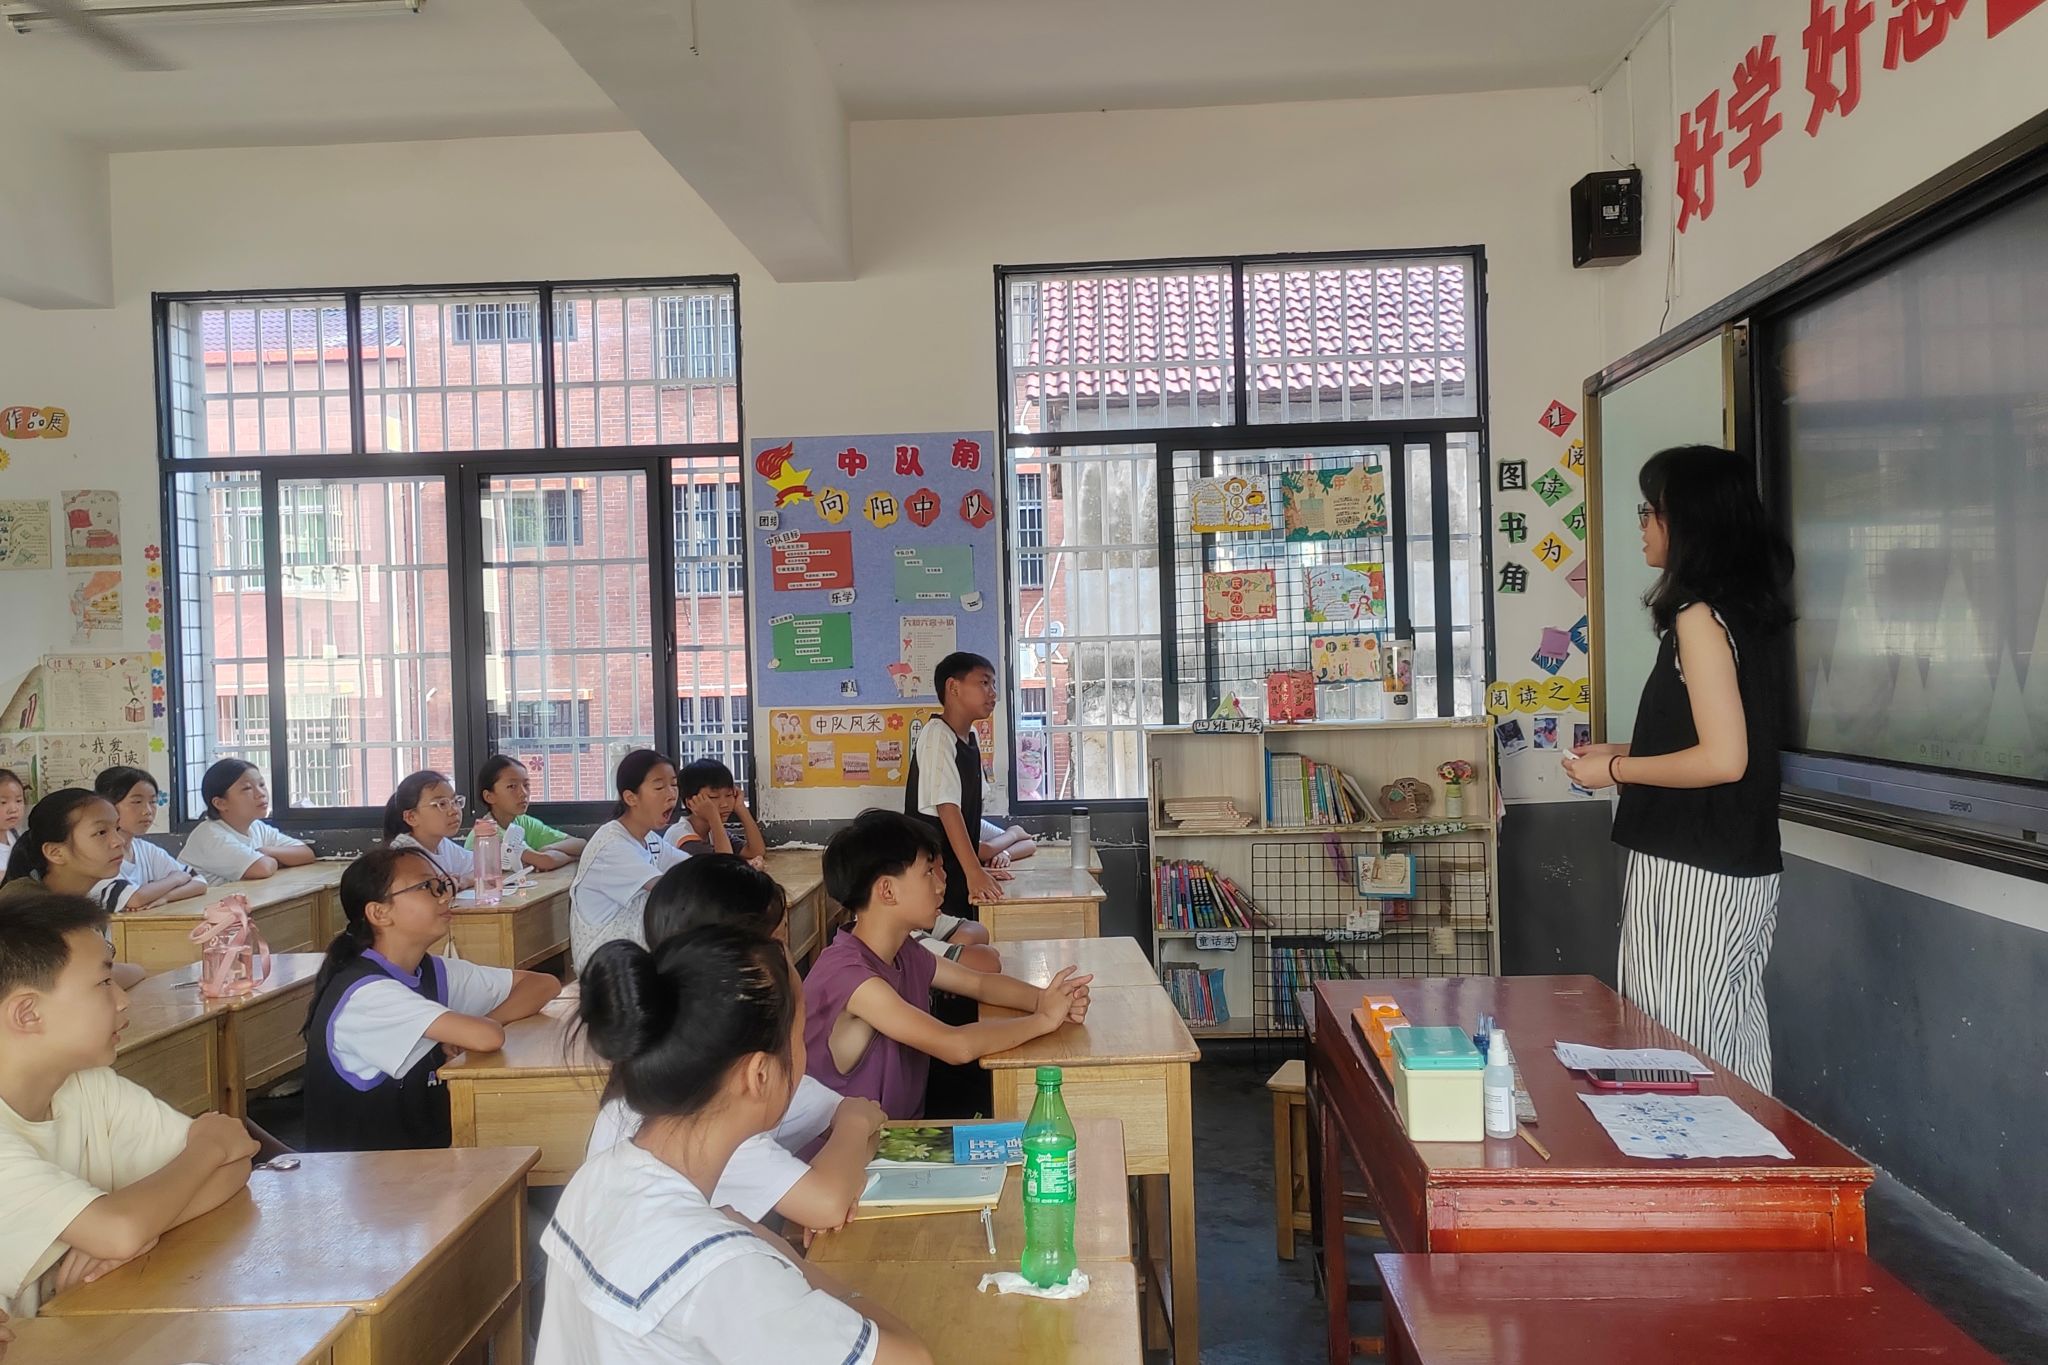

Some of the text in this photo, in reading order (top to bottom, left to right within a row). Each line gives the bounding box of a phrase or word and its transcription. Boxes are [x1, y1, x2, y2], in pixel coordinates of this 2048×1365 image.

[1674, 35, 1783, 233] 好学
[6, 408, 66, 433] 作品展
[838, 439, 980, 477] 中队角
[820, 490, 993, 523] 向阳中队
[760, 516, 778, 527] 团结
[1497, 461, 1530, 594] 图书角
[766, 531, 800, 547] 中队目标
[831, 592, 853, 604] 乐学
[1490, 682, 1589, 710] 阅读之星
[816, 716, 885, 733] 中队风采
[1198, 935, 1236, 947] 童话类
